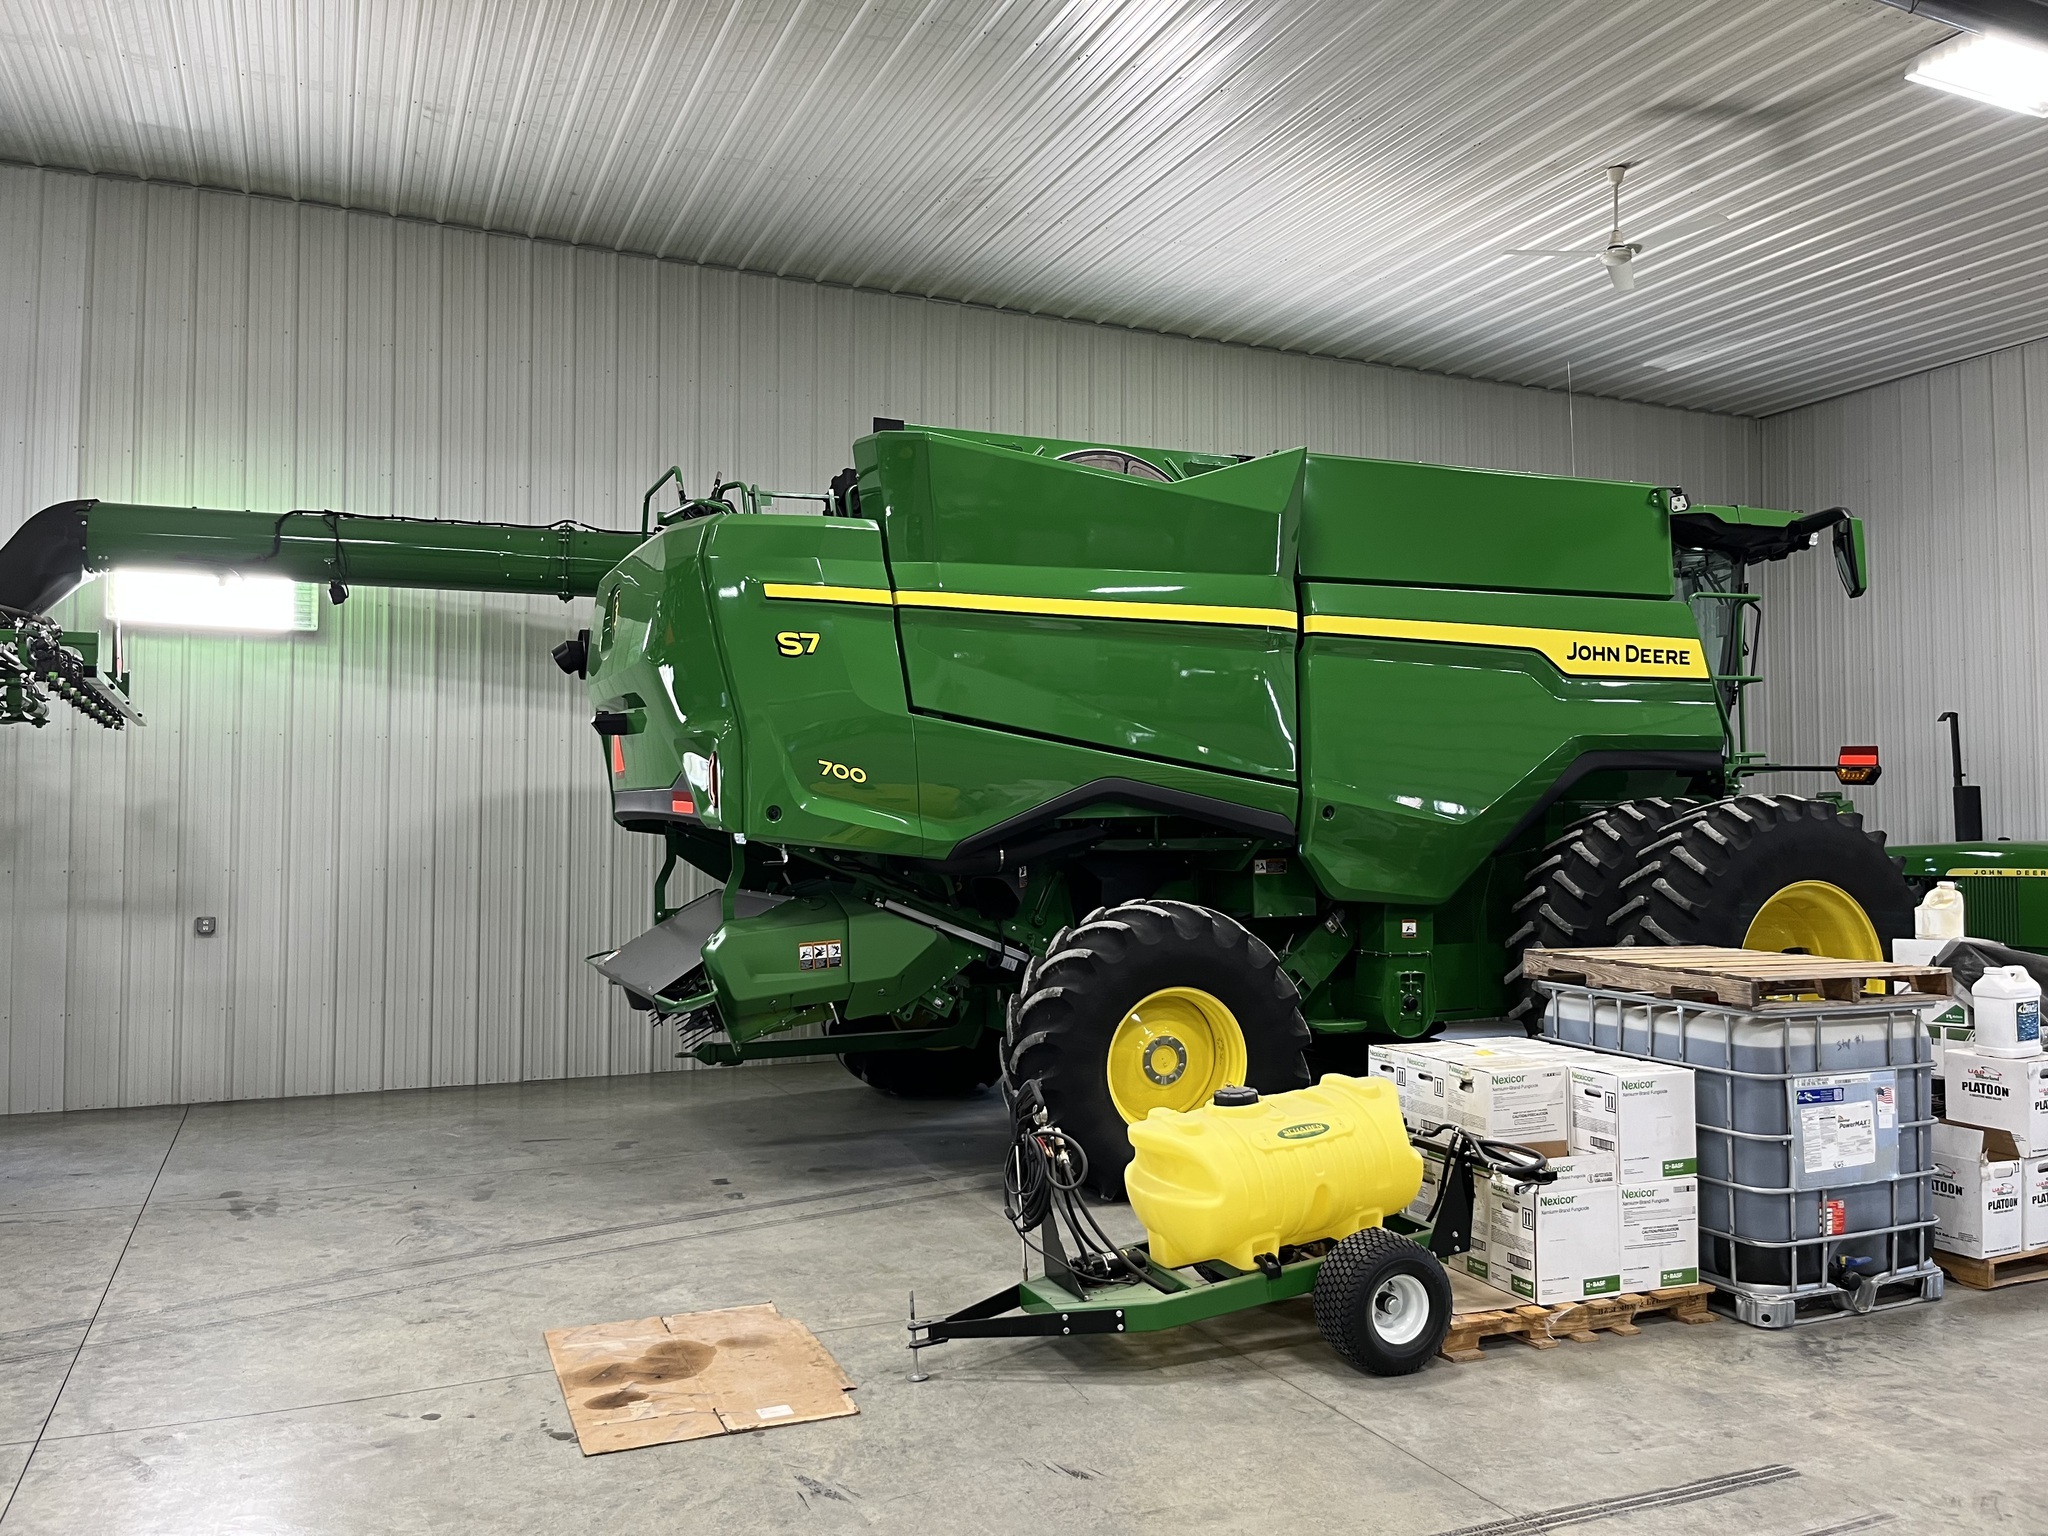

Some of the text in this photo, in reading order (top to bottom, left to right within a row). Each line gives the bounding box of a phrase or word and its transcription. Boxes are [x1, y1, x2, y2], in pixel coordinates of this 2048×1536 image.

[776, 631, 821, 658] S7
[1566, 641, 1691, 666] JOHN DEERE
[818, 758, 867, 784] 700
[1491, 1074, 1526, 1085] Nexicor
[1571, 1071, 1594, 1082] Nexicor
[1621, 1080, 1655, 1090] Nexicor
[1961, 1081, 2009, 1097] PLATOON
[2034, 1099, 2048, 1111] PLA
[1621, 1188, 1657, 1199] Nexicor
[2032, 1192, 2048, 1205] PLAT
[1539, 1194, 1576, 1207] Nexicor
[1987, 1197, 2018, 1211] PLATOON
